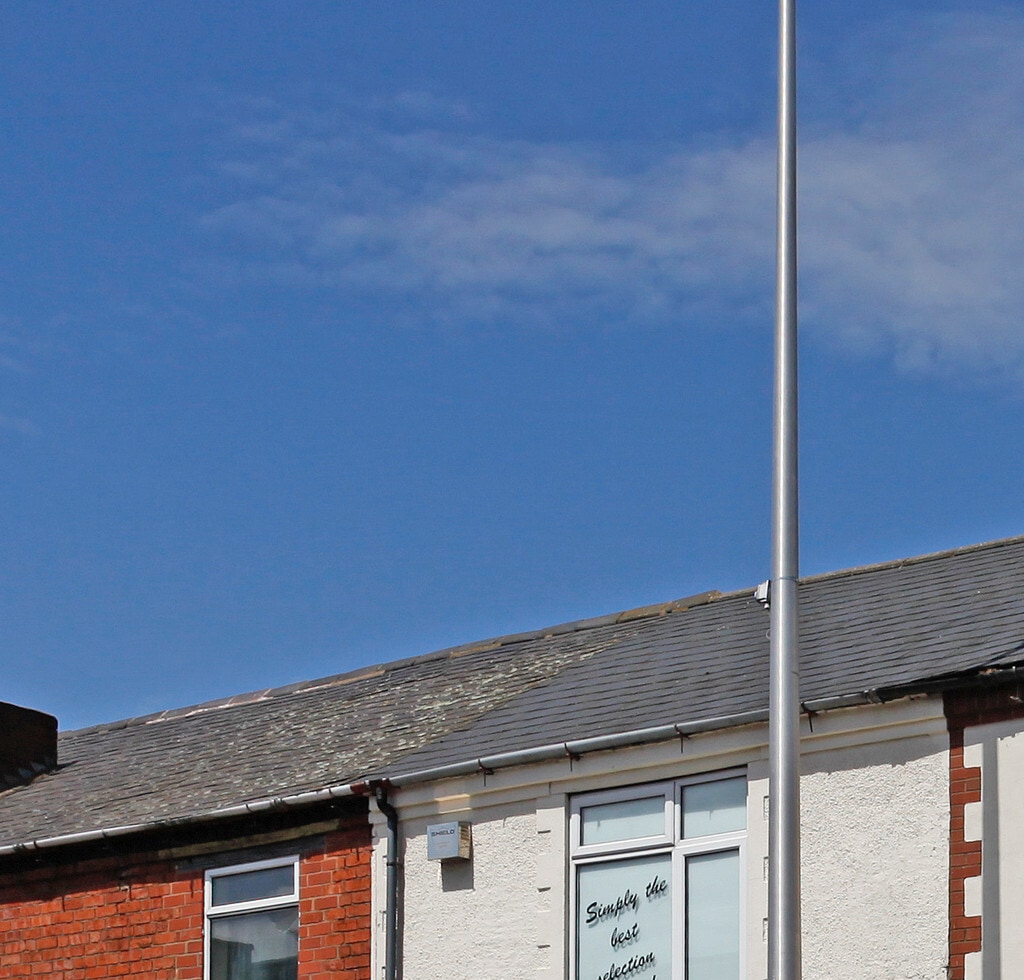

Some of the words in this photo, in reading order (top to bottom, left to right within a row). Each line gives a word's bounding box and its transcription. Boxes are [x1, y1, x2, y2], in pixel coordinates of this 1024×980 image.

[586, 889, 638, 924] Simply
[645, 875, 668, 898] the
[610, 923, 638, 948] best
